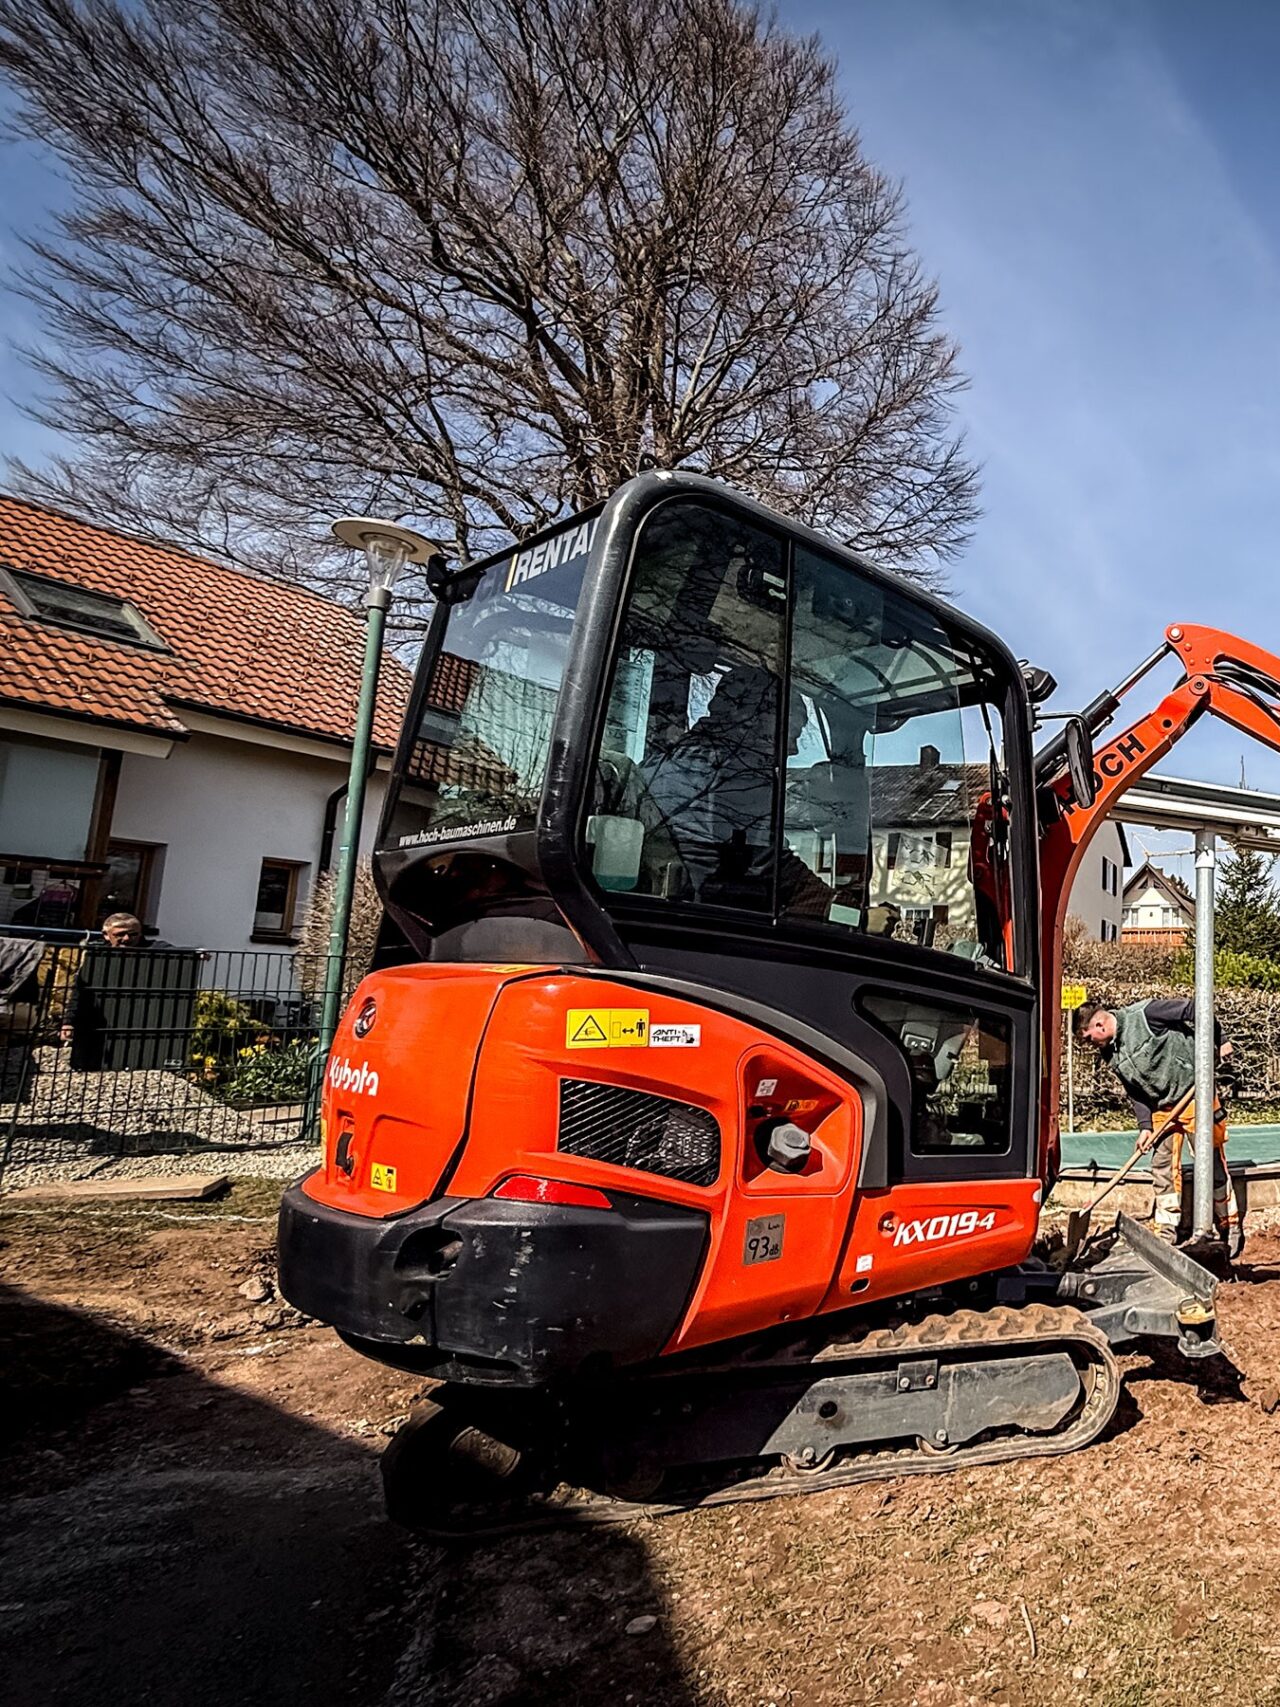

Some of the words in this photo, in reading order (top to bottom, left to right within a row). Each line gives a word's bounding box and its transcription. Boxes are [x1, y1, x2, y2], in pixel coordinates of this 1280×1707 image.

[399, 815, 517, 847] www.hoch-baumaschinen.de
[329, 1055, 379, 1097] Kubota
[893, 1211, 996, 1247] KX019-4
